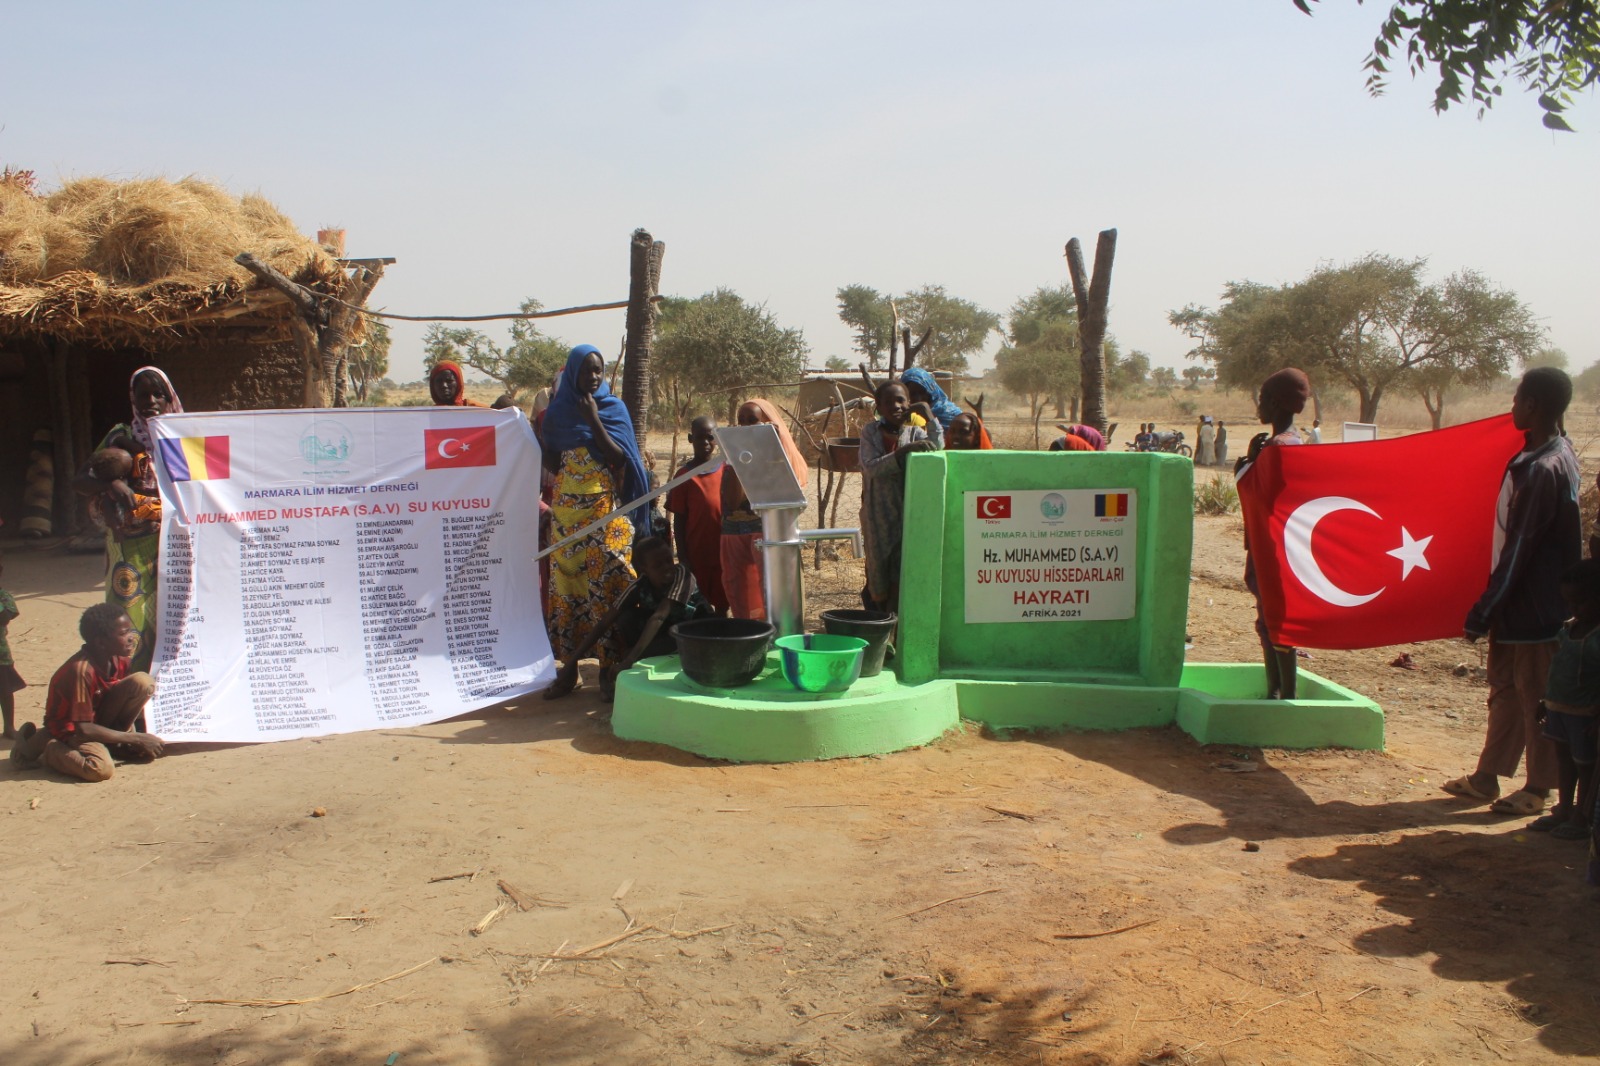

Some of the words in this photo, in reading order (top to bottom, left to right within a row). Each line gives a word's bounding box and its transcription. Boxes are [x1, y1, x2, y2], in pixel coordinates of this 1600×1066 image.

[244, 488, 301, 499] MARMARA
[303, 486, 324, 496] İLİM
[327, 485, 367, 495] HİZMET
[371, 481, 419, 493] DERNEĞİ
[195, 508, 277, 525] MUHAMMED
[281, 505, 350, 519] MUSTAFA
[353, 502, 401, 517] (S.A.V)
[408, 501, 428, 513] SU
[432, 498, 491, 511] KUYUSU
[981, 531, 1027, 539] MARMARA
[1029, 530, 1048, 538] İLİM
[1049, 530, 1081, 538] HİZMET
[983, 549, 1002, 563] Hz.
[1005, 547, 1076, 562] MUHAMMED
[1080, 545, 1119, 563] (S.A.V)
[977, 569, 992, 583] SU
[995, 568, 1041, 583] KUYUSU
[1043, 565, 1125, 582] HİSSEDARLARI
[1013, 590, 1090, 605] HAYRATI
[1021, 608, 1058, 618] AFRİKA
[1060, 609, 1081, 617] 2021
